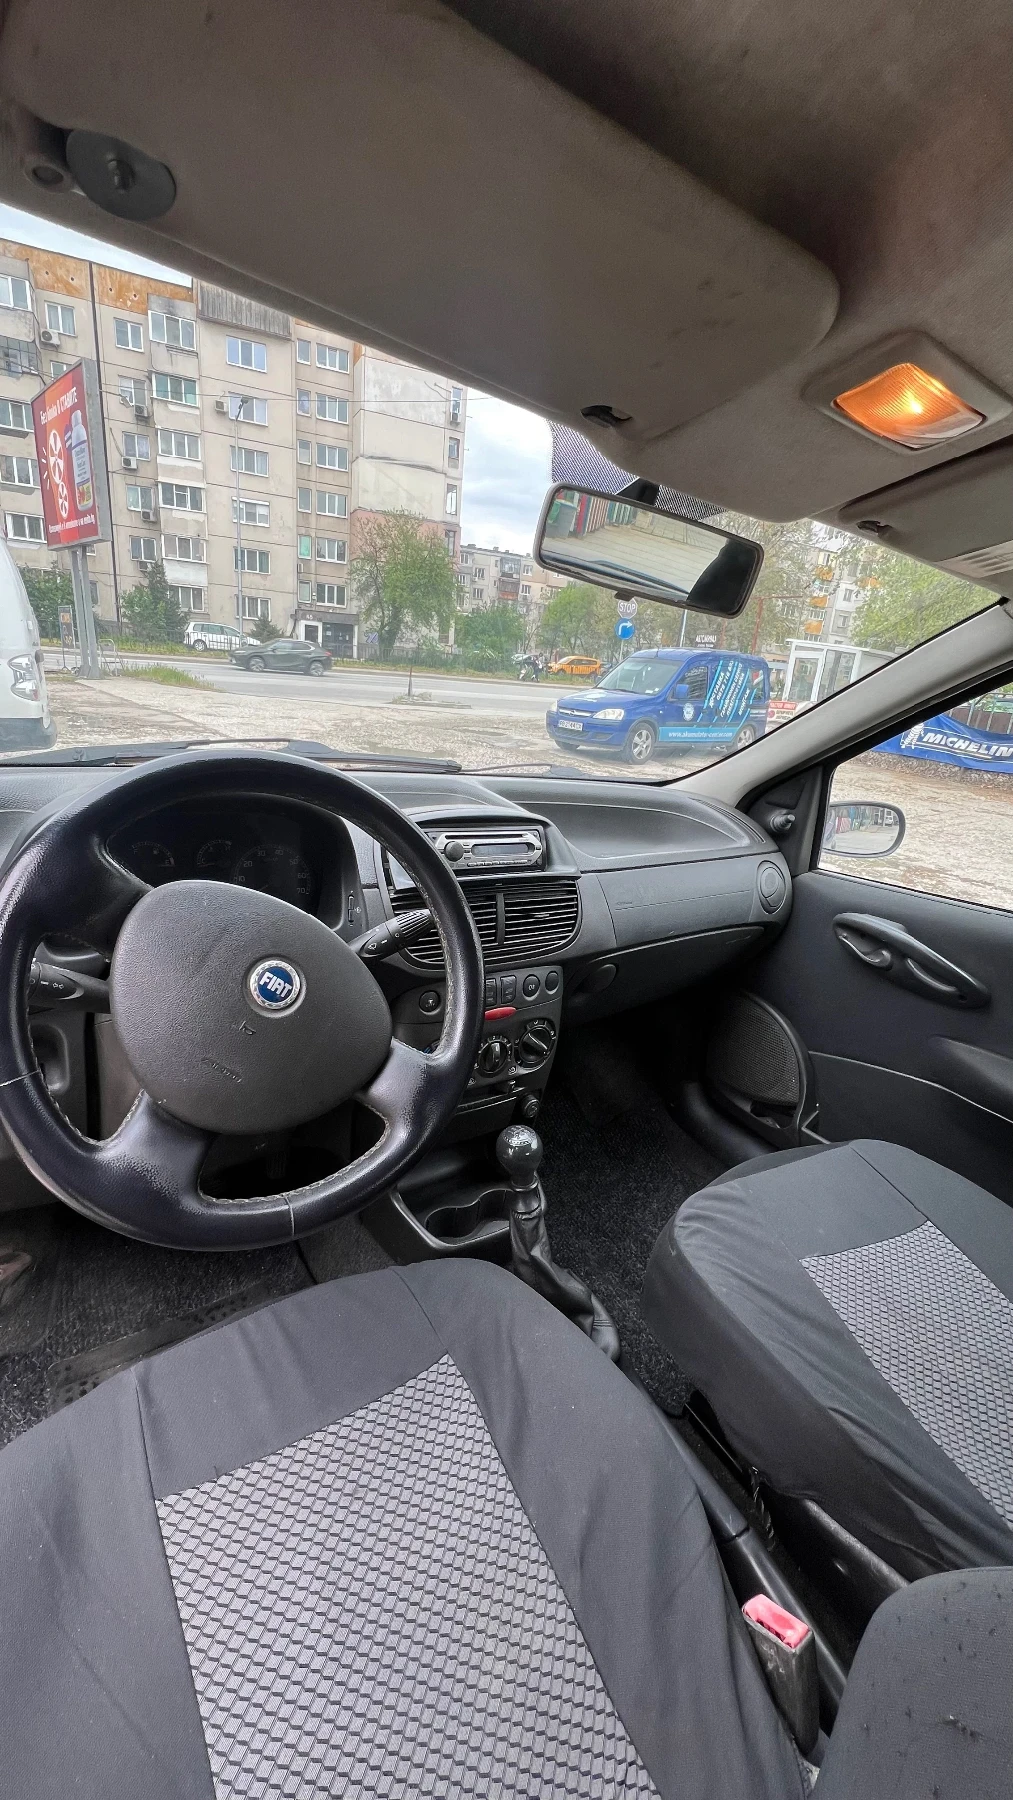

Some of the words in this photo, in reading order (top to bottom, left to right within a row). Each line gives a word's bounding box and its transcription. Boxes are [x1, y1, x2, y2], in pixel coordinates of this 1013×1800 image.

[619, 602, 636, 613] STOP
[709, 672, 725, 709] ДОСТАВКА
[922, 732, 1013, 757] MICHELIN
[243, 860, 253, 868] 20
[259, 971, 293, 998] FIAT
